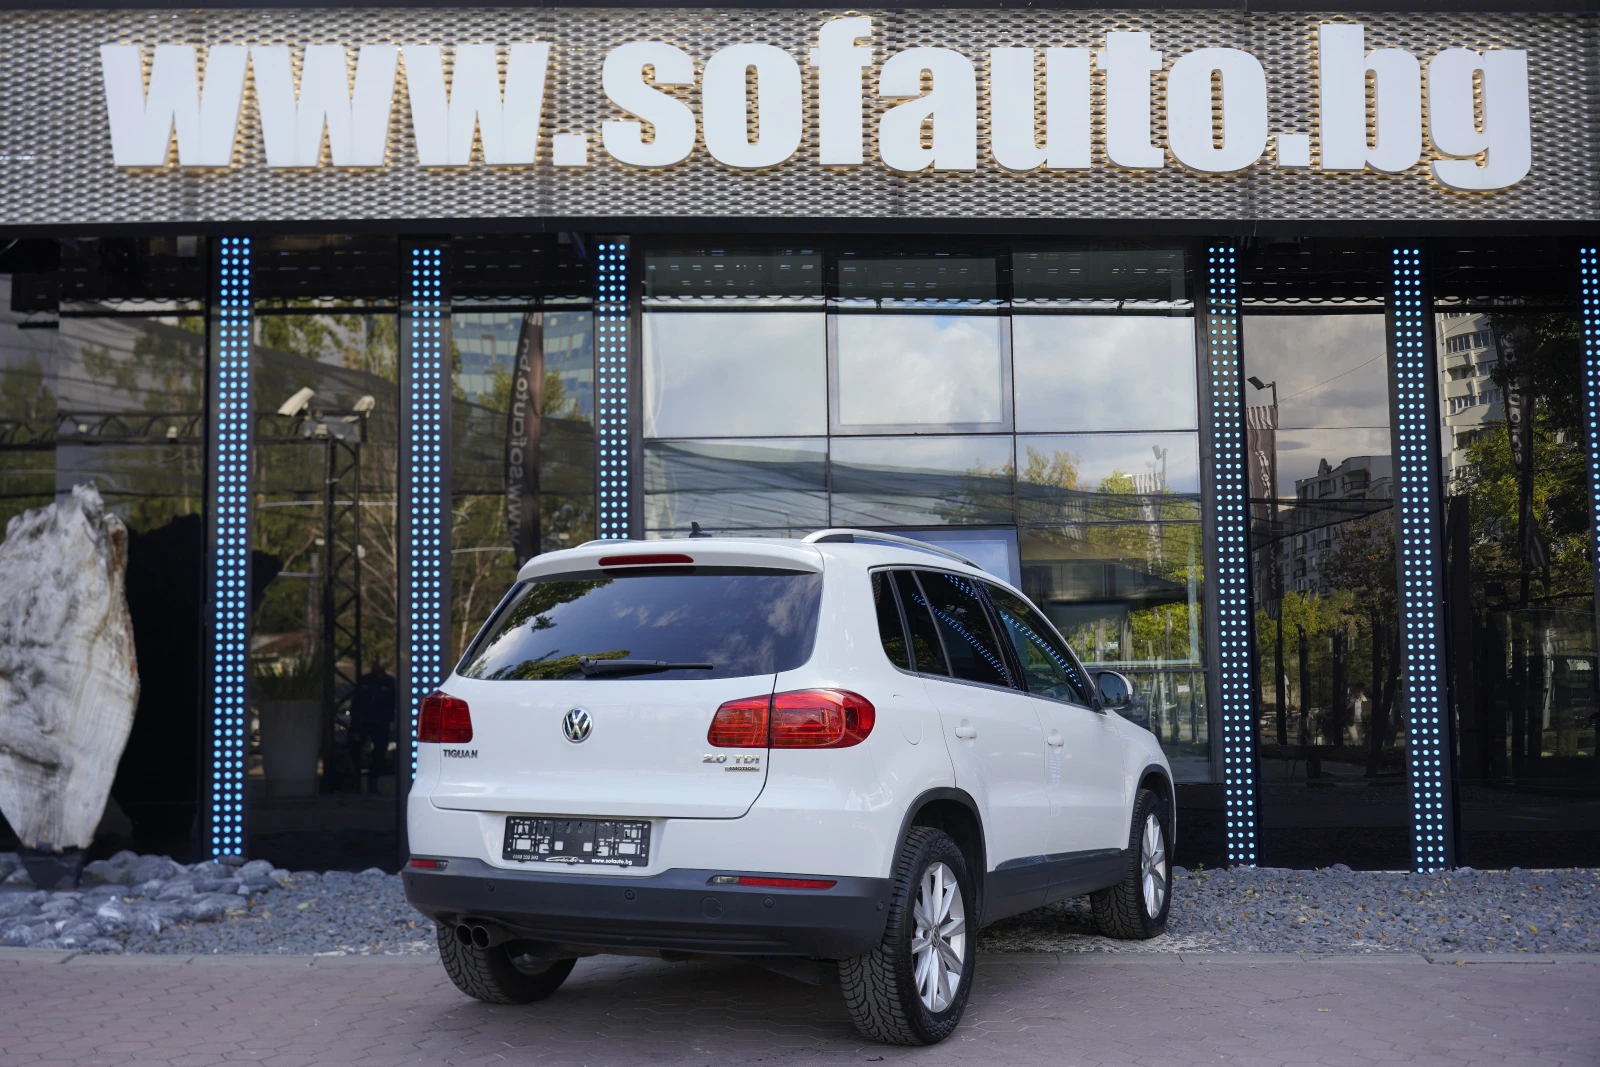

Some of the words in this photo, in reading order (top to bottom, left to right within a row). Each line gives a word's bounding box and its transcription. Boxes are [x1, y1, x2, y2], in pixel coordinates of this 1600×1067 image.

[100, 16, 1531, 190] www.sofauto.bg
[442, 749, 478, 758] TIGUAN
[702, 753, 727, 764] 2.0
[733, 754, 760, 764] TDI
